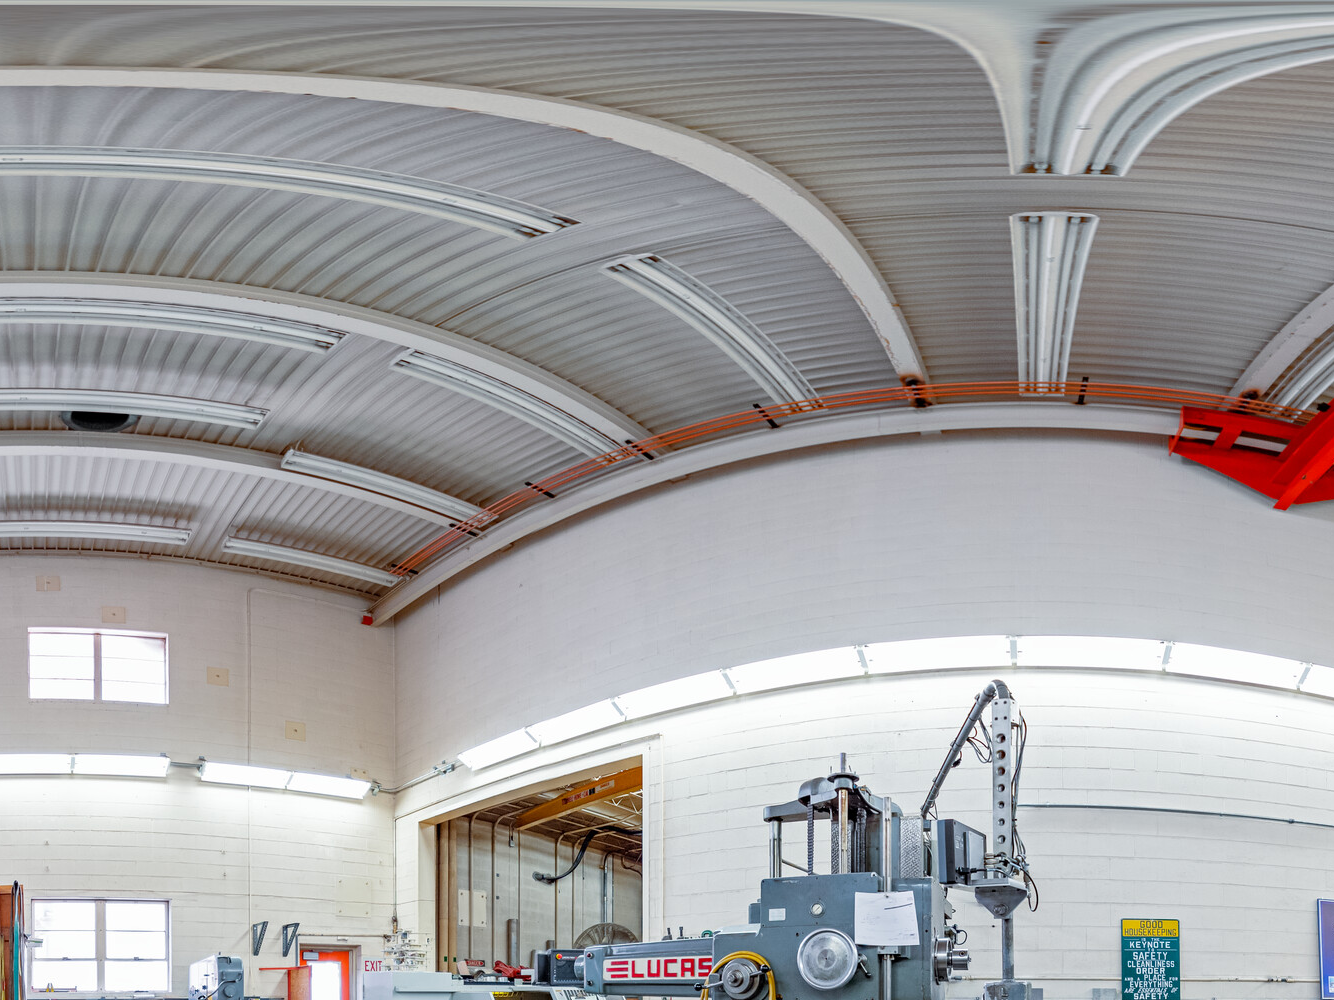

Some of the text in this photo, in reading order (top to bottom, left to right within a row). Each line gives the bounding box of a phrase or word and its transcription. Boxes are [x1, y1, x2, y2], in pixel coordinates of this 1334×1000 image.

[1139, 920, 1164, 929] GOOD
[1124, 928, 1177, 936] HOUSEKEEPING
[1129, 941, 1171, 949] KEYNOTE
[1132, 951, 1168, 960] SAFETY
[364, 960, 383, 972] EXIT
[631, 957, 713, 978] LUCAS
[1127, 960, 1175, 968] CLEANLINESS
[1136, 967, 1166, 975] ORDER
[1129, 980, 1173, 988] EVERYTHING
[1133, 992, 1169, 1000] SAFETY
